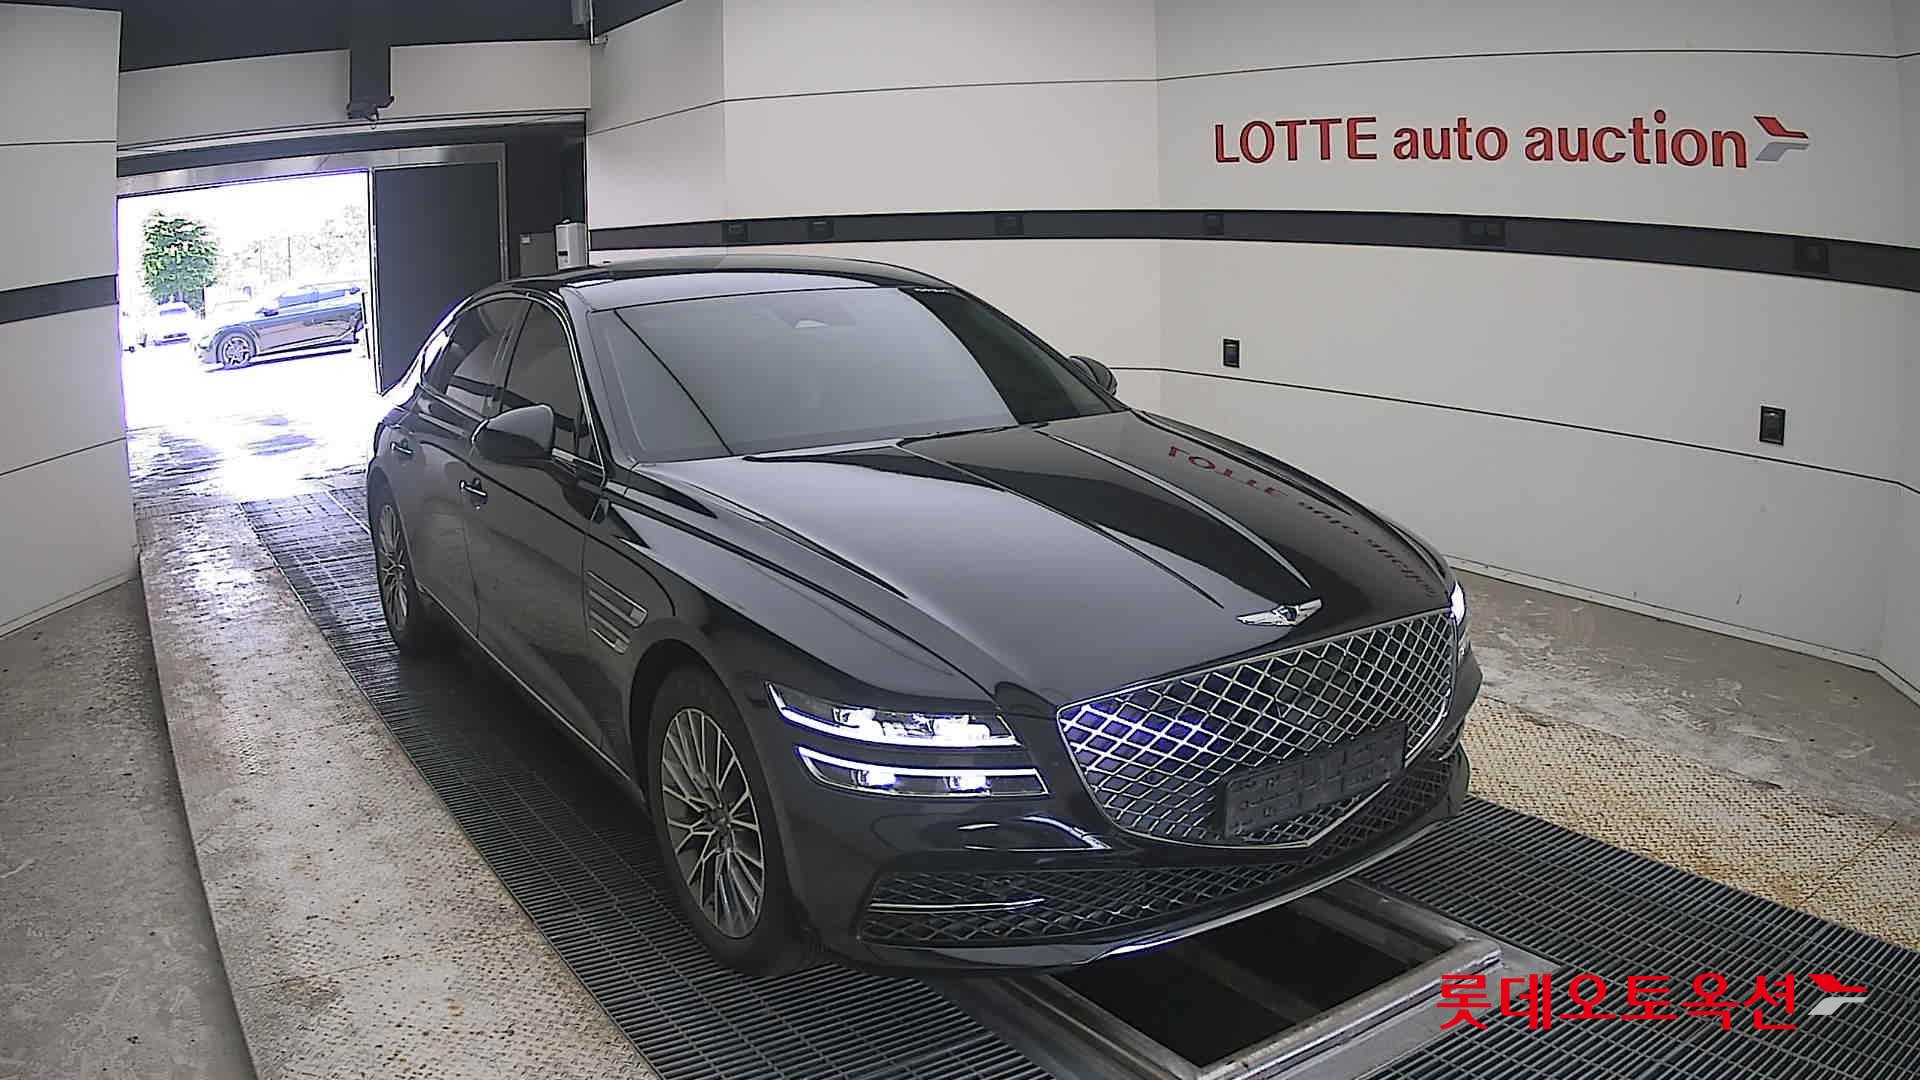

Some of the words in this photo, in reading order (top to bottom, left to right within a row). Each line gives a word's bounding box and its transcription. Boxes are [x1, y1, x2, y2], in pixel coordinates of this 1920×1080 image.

[1214, 116, 1377, 164] LOTTE
[1392, 116, 1509, 161] auto
[1524, 110, 1748, 168] auction
